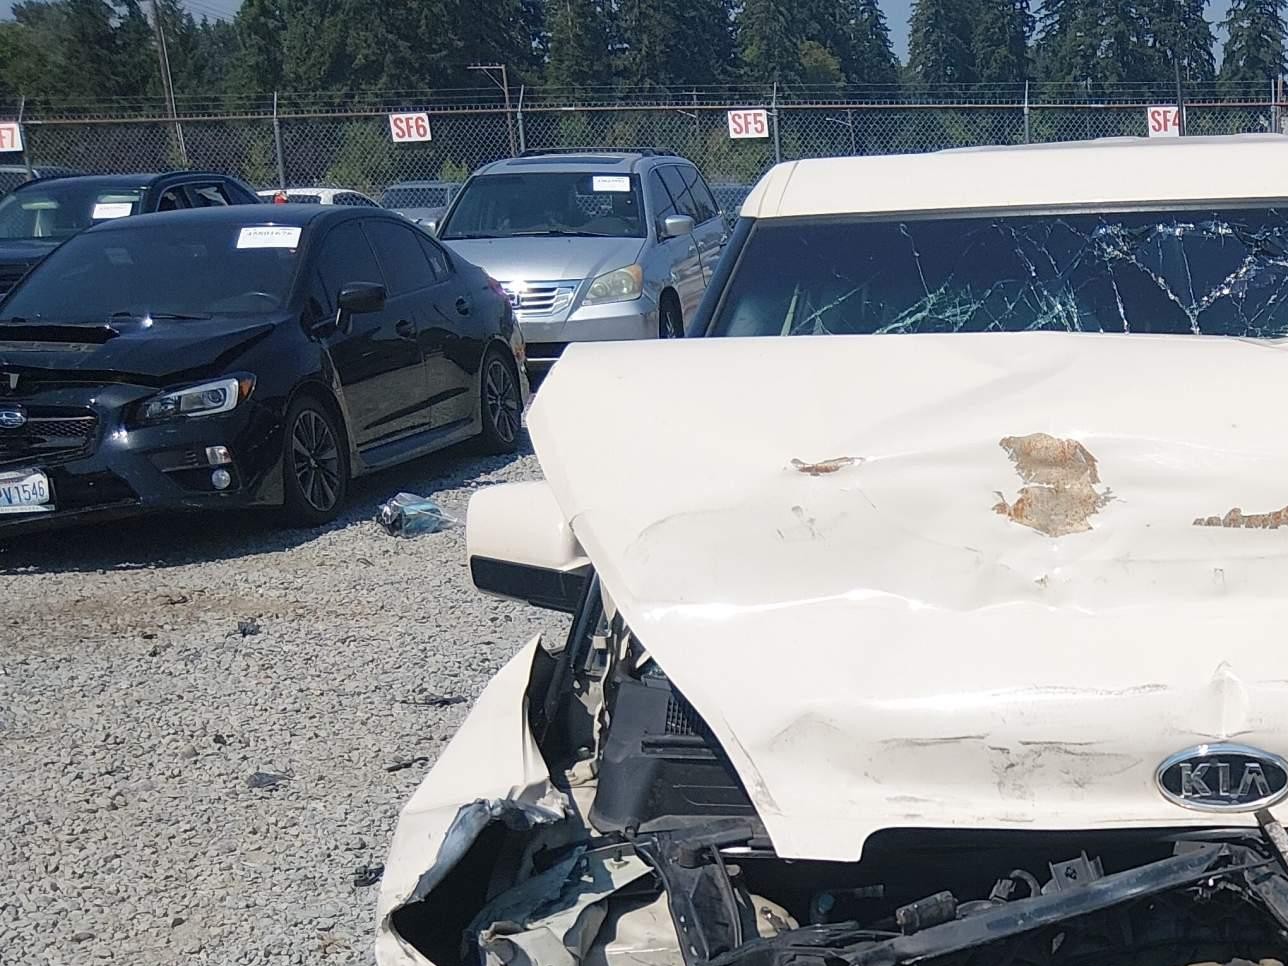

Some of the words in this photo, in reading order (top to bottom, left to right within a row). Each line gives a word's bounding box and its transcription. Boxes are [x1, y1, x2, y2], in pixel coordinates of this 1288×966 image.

[393, 116, 428, 138] SF6
[731, 112, 765, 135] SF5
[0, 480, 45, 504] V1546
[1179, 762, 1273, 797] KIA
